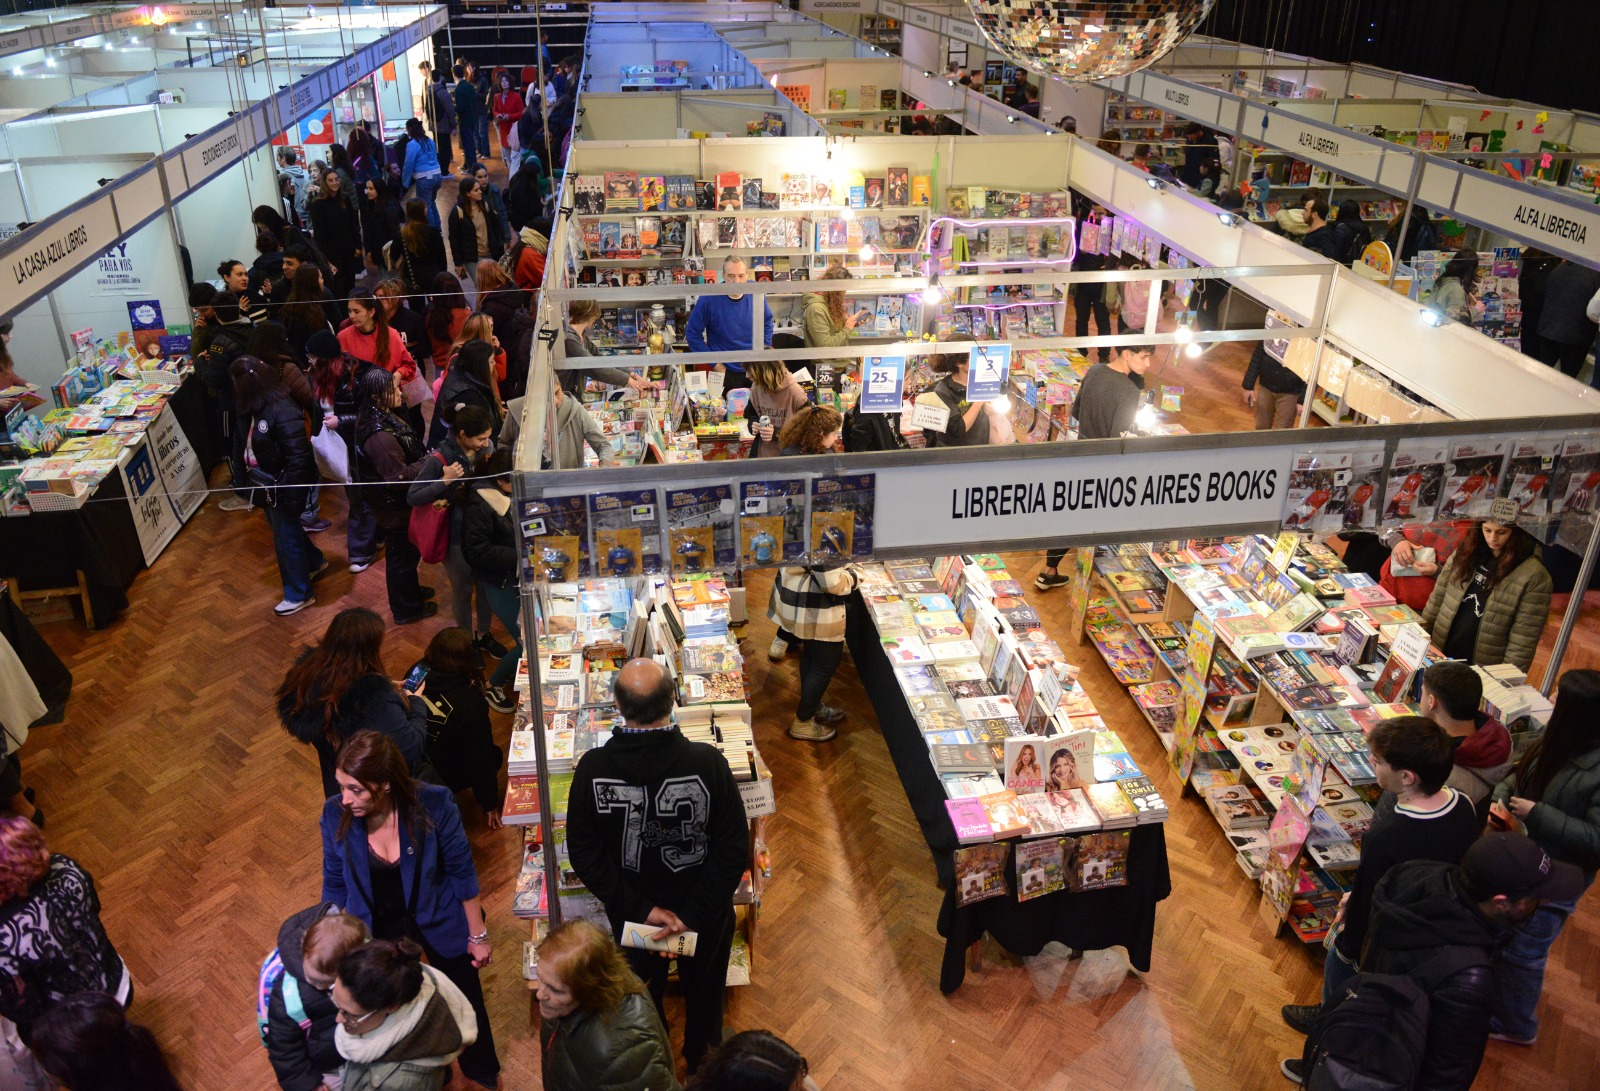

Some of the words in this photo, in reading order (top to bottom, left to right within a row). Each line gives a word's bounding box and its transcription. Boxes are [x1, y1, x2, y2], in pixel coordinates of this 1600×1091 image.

[1298, 132, 1313, 148] ALFA
[1313, 136, 1339, 157] LIBRERIA
[1513, 204, 1540, 229] ALFA
[1539, 212, 1587, 245] LIBRERIA
[13, 261, 28, 285] LA
[24, 249, 49, 277] CASA
[46, 239, 66, 266] AZUL
[64, 224, 88, 255] LIBROS
[98, 259, 119, 272] PARA
[119, 258, 133, 272] VOS
[985, 359, 994, 371] 3
[871, 372, 888, 383] 25
[157, 435, 180, 462] libros
[952, 482, 1047, 519] LIBRERIA
[1052, 475, 1137, 512] BUENOS
[1140, 471, 1202, 506] AIRES
[1205, 468, 1278, 503] BOOKS
[987, 719, 1006, 740] GIRL
[1007, 778, 1045, 789] CANDE
[1122, 781, 1140, 790] JOE
[1125, 785, 1156, 796] COWLEY
[592, 774, 711, 873] 73
